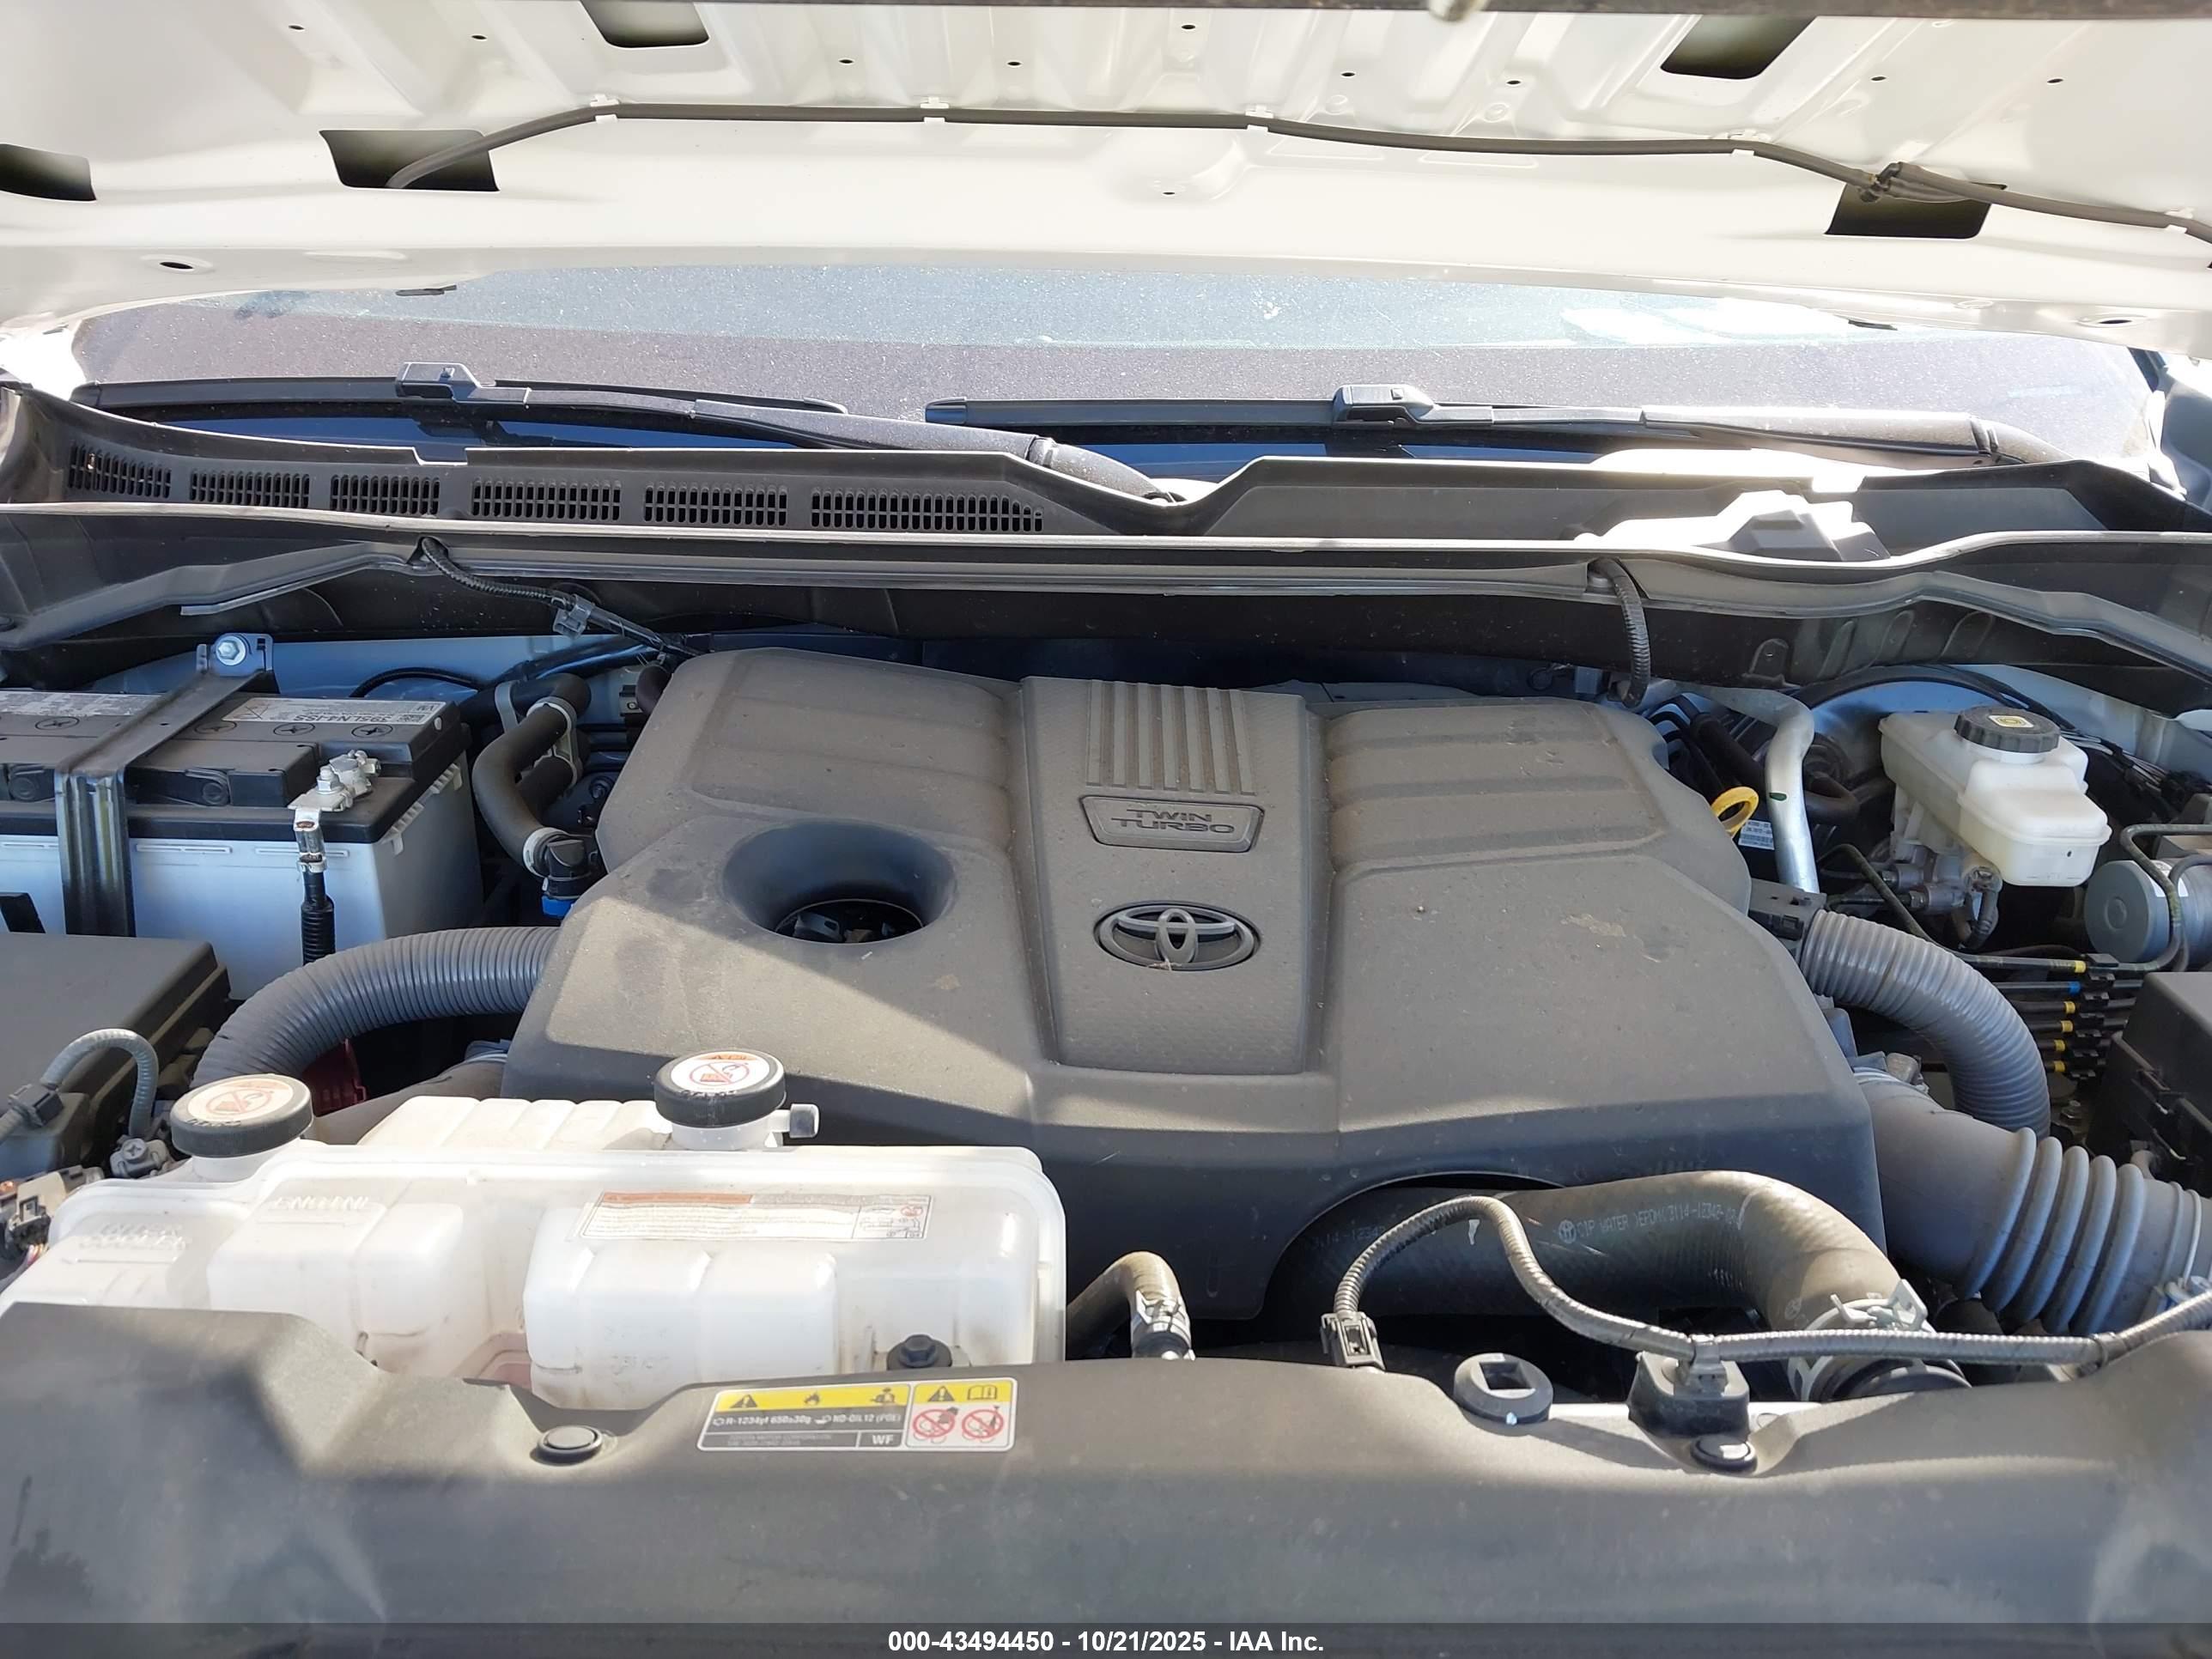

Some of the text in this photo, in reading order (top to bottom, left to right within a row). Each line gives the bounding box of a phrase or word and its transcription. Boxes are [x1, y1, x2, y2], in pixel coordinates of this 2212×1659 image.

[1126, 809, 1212, 822] TWIN
[1110, 817, 1235, 833] TURBO
[871, 1434, 894, 1445] WF
